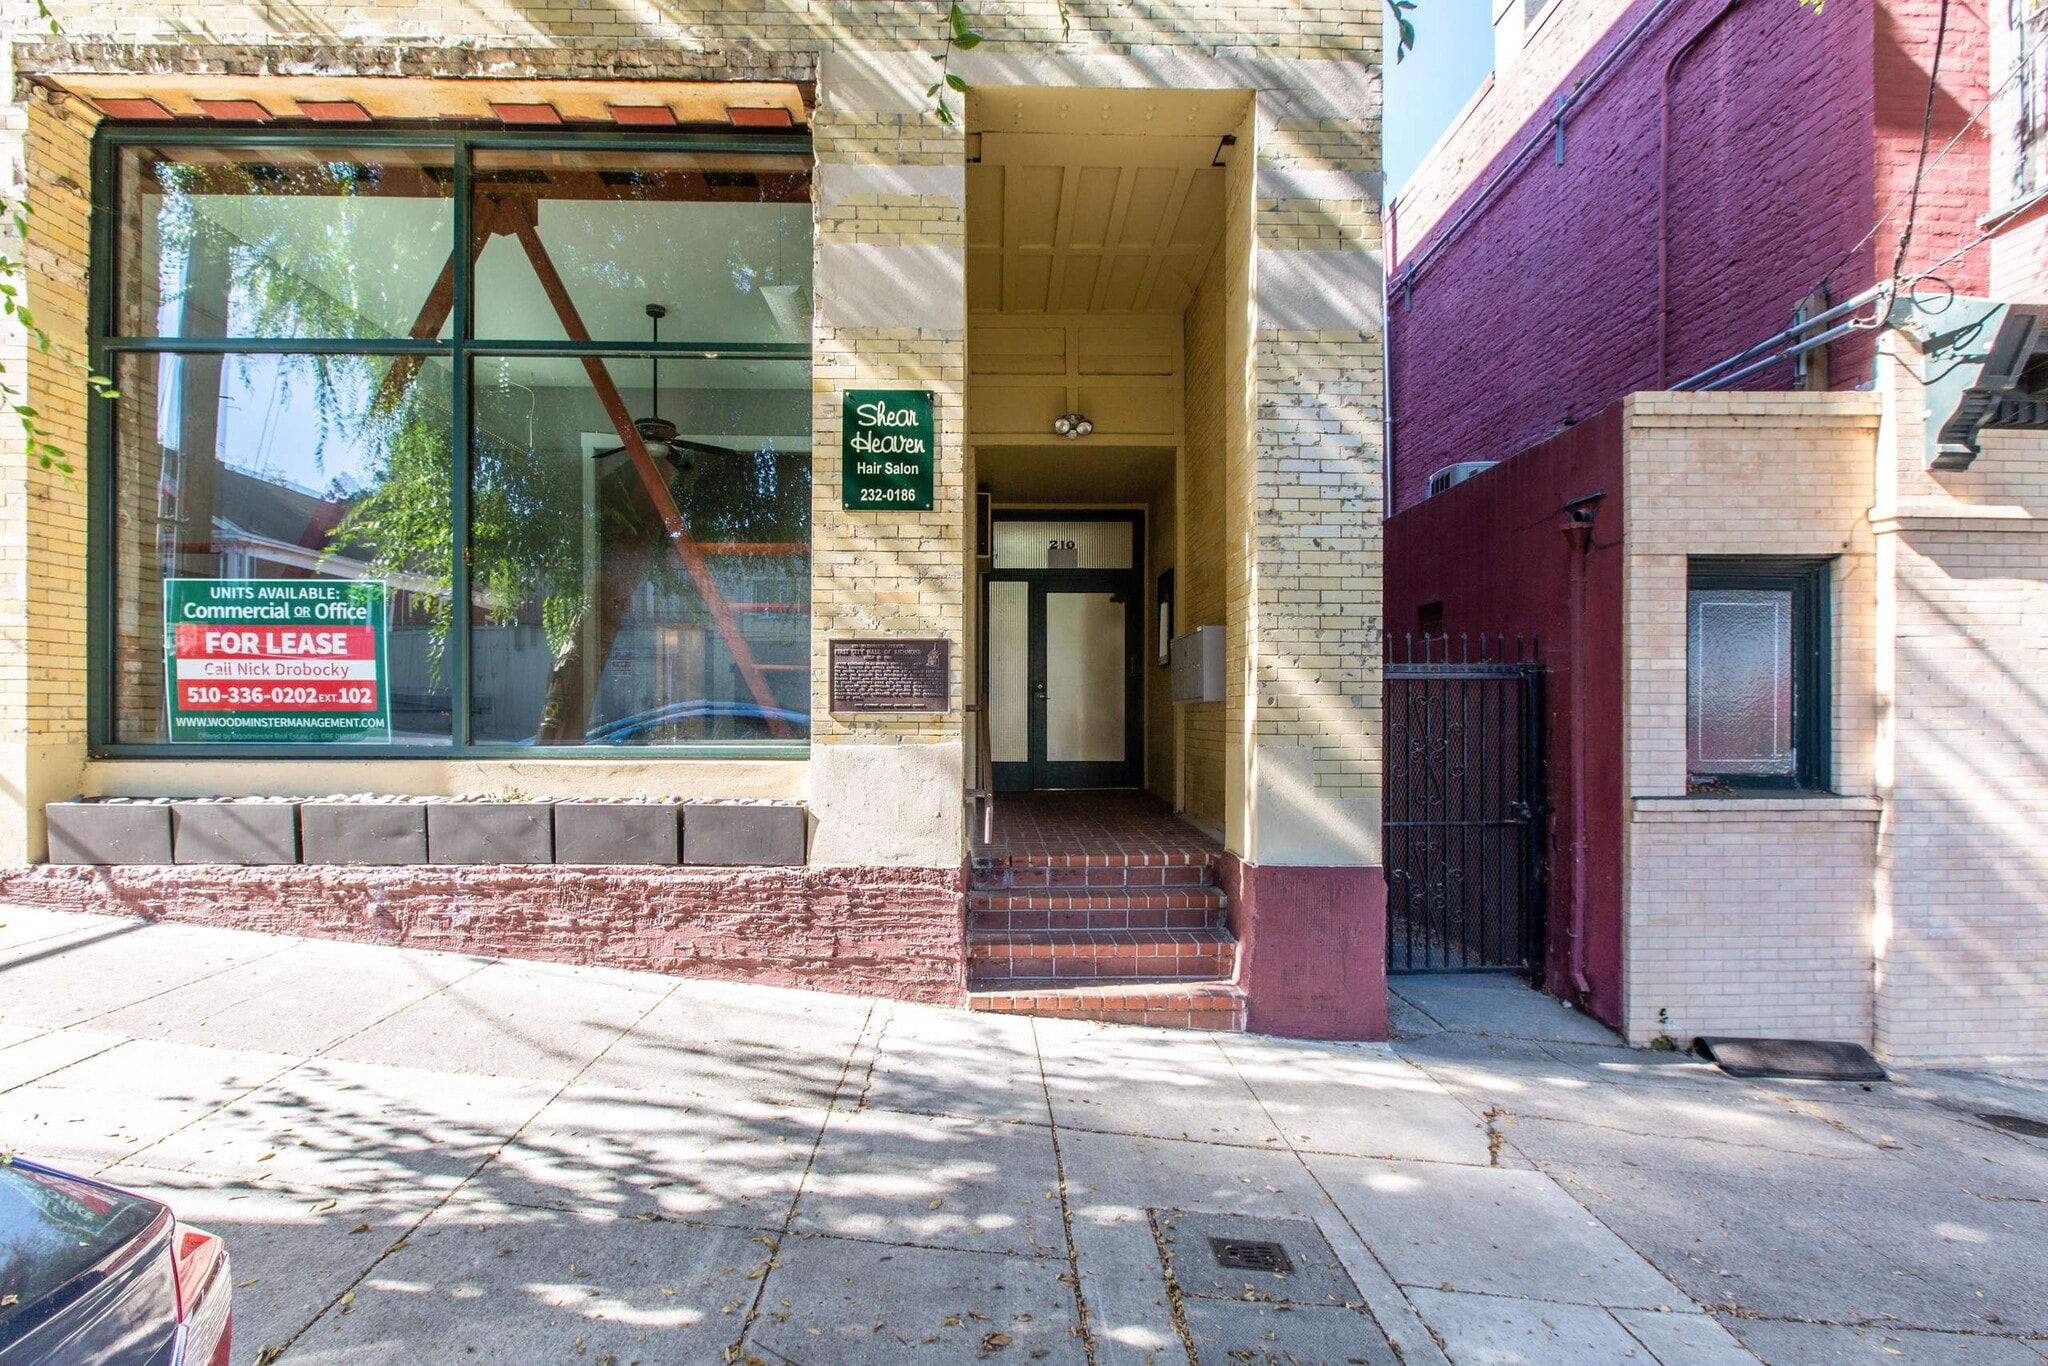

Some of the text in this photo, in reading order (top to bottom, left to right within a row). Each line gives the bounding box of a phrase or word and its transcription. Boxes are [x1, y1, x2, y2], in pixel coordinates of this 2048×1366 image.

[857, 400, 919, 427] Shear
[850, 430, 926, 454] Heaven
[857, 462, 919, 474] Hair Salon
[860, 488, 916, 502] 232-0186
[1049, 540, 1075, 550] 210
[210, 586, 340, 600] UNITS AVAILABLE:
[183, 602, 367, 620] Commercial OR Office
[205, 631, 348, 655] FOR LEASE
[204, 662, 349, 679] Call Nick Drobocky
[175, 716, 385, 728] WWW.WOODMINSTERMANAGEMENT.COM
